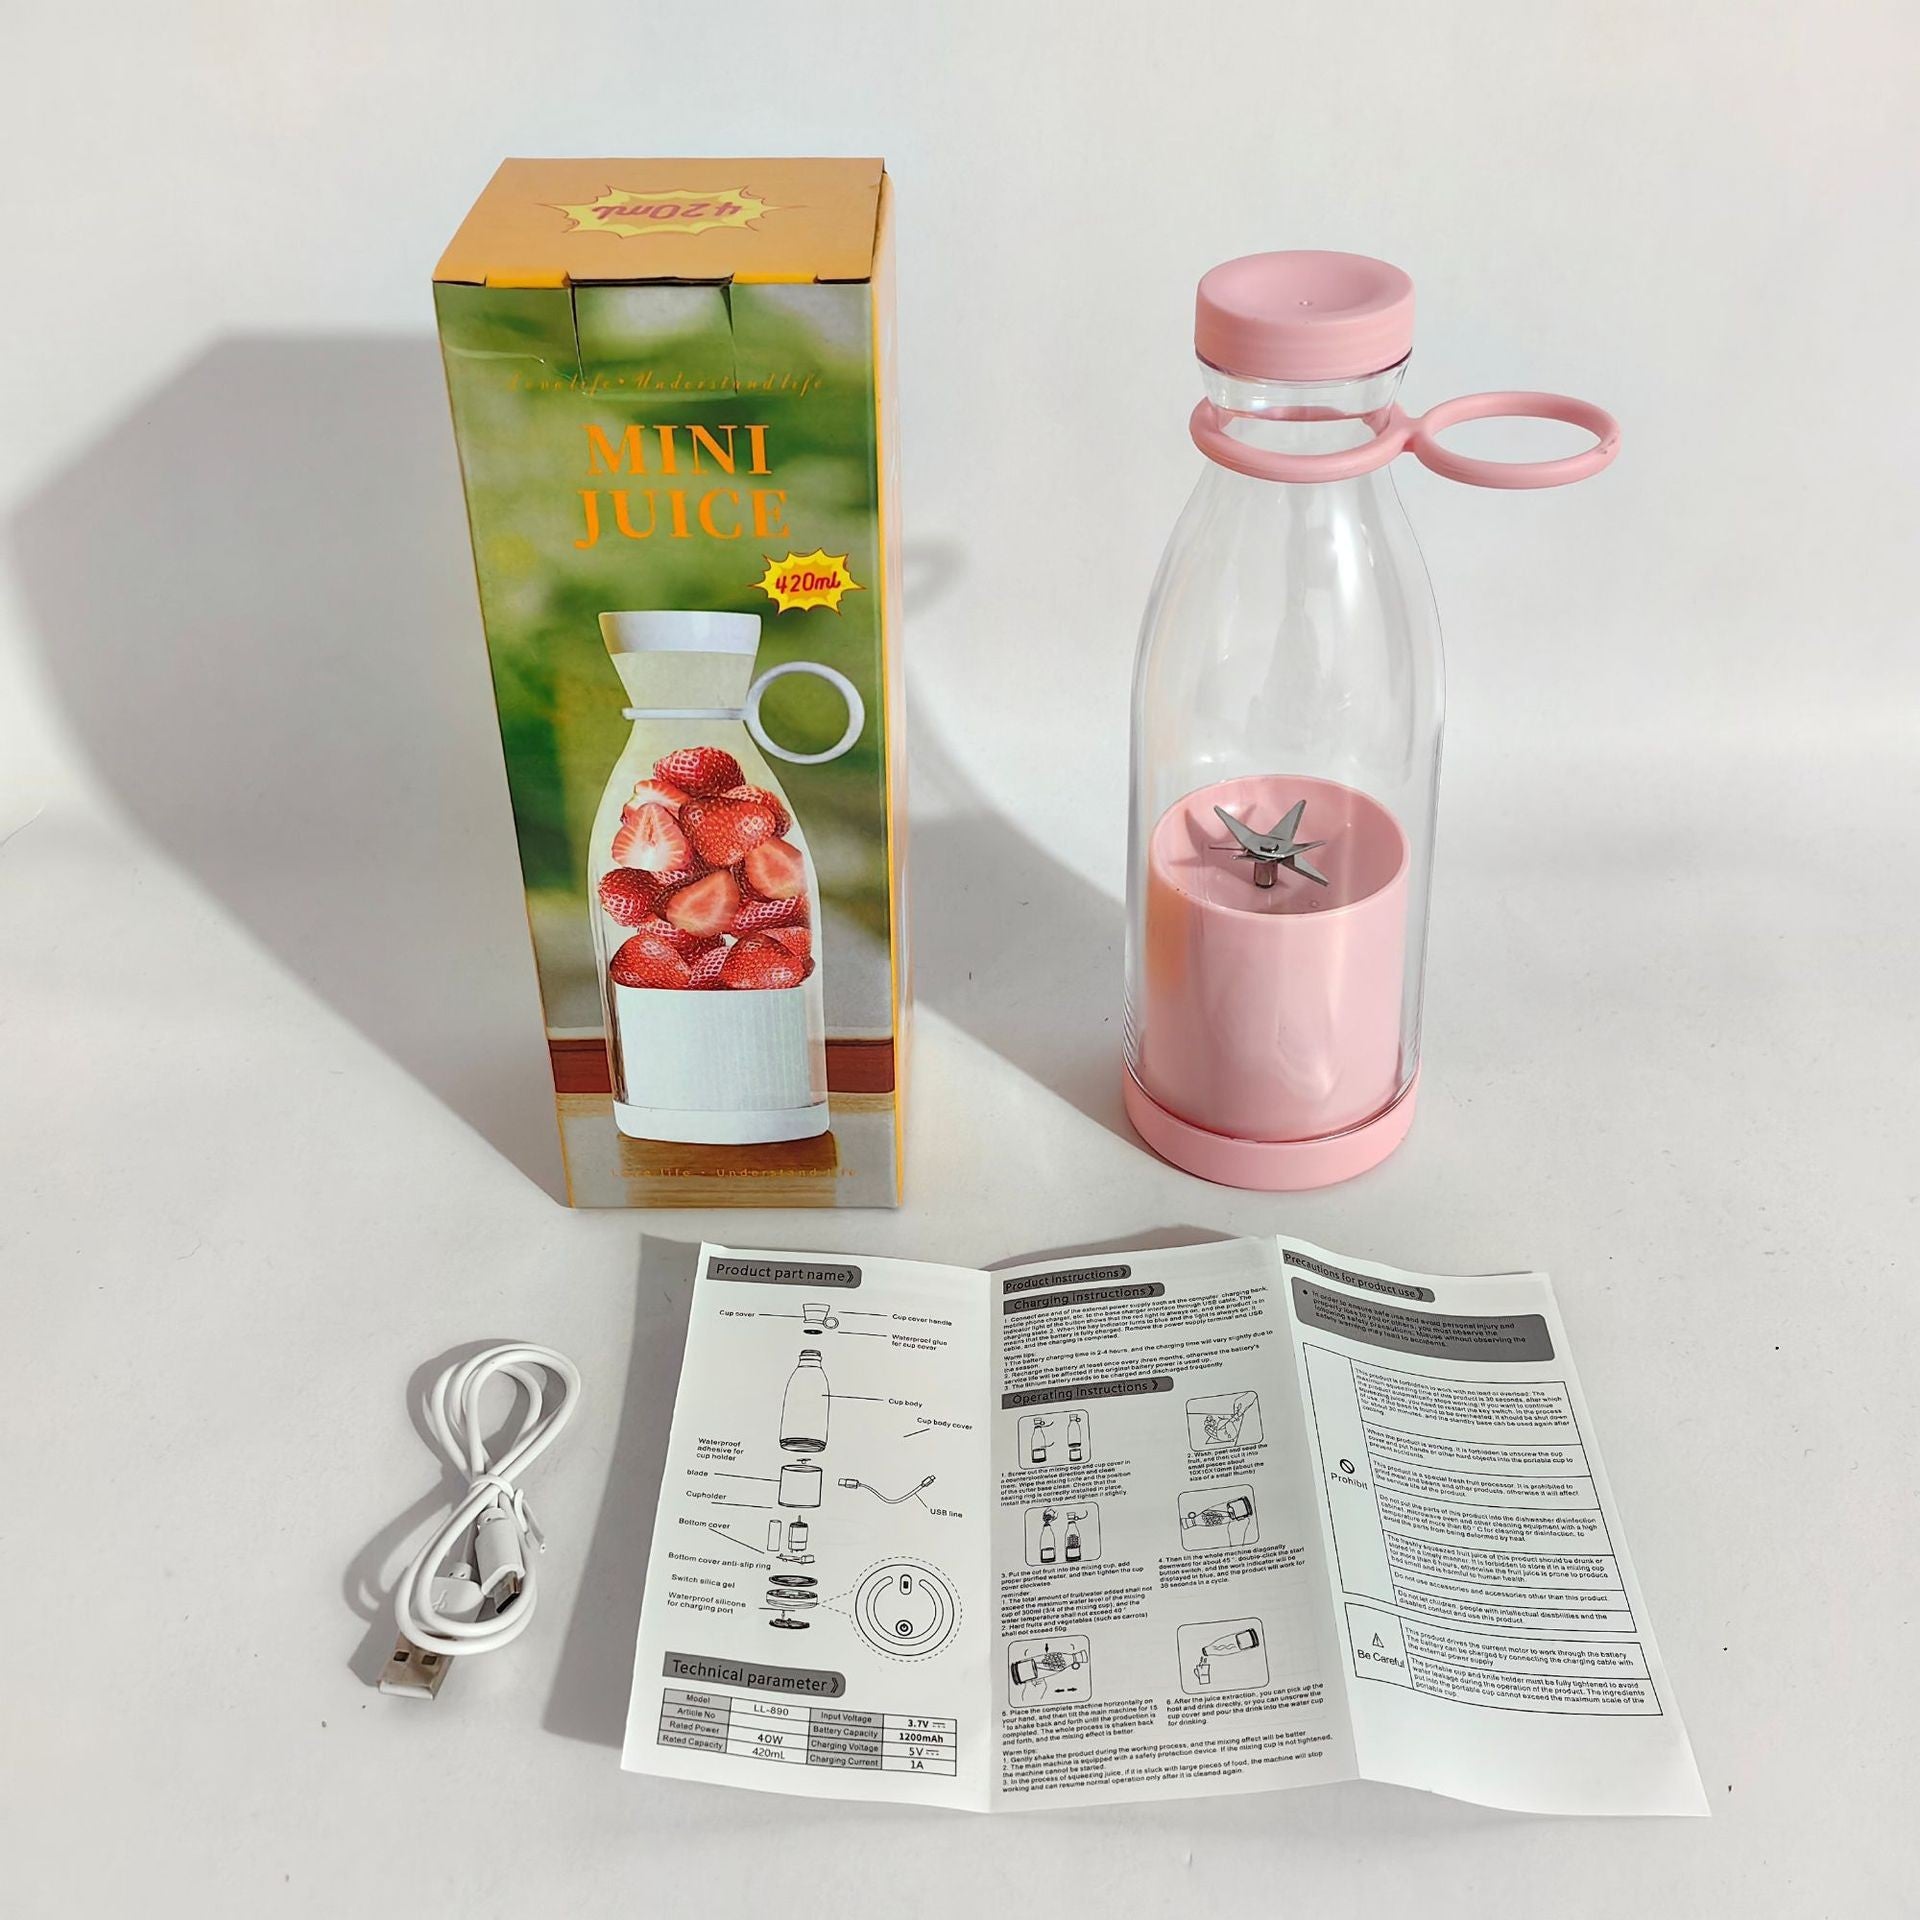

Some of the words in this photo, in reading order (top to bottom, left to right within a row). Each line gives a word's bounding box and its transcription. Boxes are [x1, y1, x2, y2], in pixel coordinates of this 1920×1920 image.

[580, 424, 772, 475] MINI
[573, 487, 791, 550] JUICE
[774, 571, 841, 594] 420ml
[716, 1263, 772, 1277] Product
[775, 1268, 804, 1282] part
[807, 1271, 844, 1281] name
[1285, 1253, 1339, 1279] Precautions
[1341, 1272, 1356, 1285] for
[1358, 1281, 1396, 1294] product
[1398, 1289, 1416, 1297] use
[1331, 1472, 1368, 1489] Prohibit
[1358, 1649, 1371, 1660] Be
[1372, 1652, 1405, 1667] Careful
[673, 1659, 744, 1680] Technical
[747, 1672, 827, 1691] parameter
[754, 1704, 789, 1716] LL-890
[908, 1719, 928, 1729] 3.7V
[758, 1733, 783, 1745] 40W
[900, 1732, 944, 1743] 1200mAh
[752, 1748, 785, 1759] 420mL
[909, 1747, 924, 1756] 5V
[911, 1760, 924, 1770] 1A
